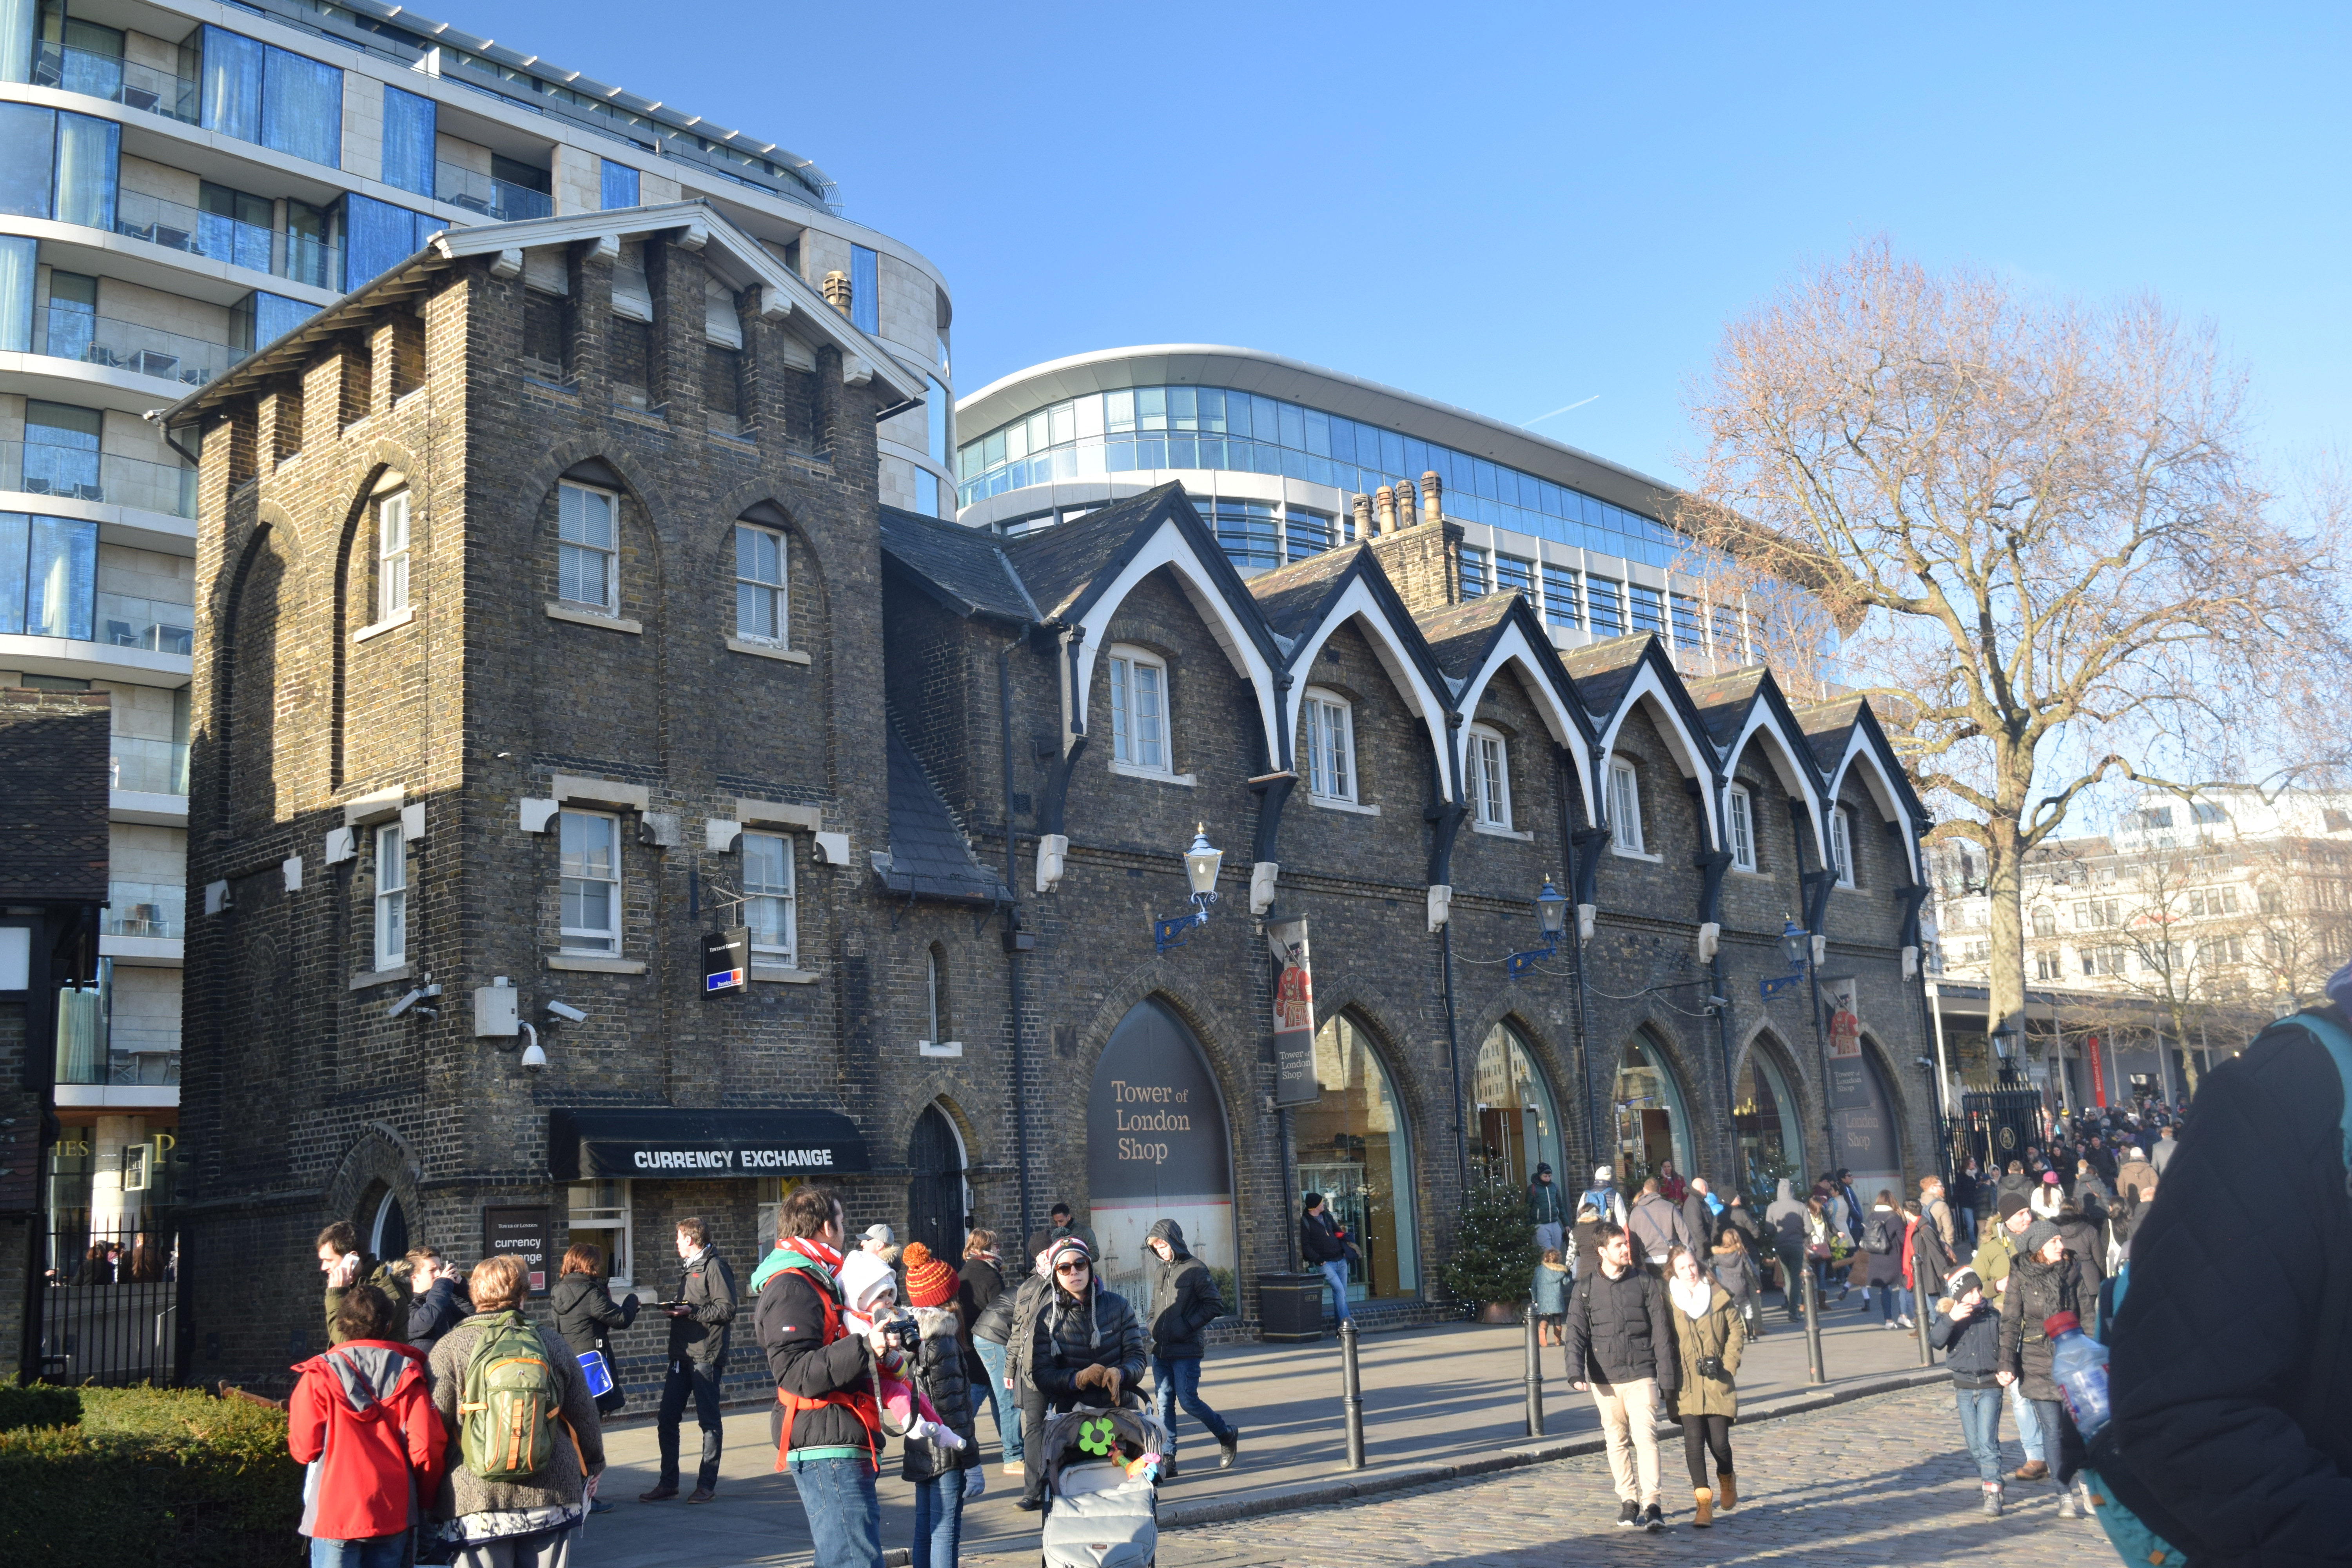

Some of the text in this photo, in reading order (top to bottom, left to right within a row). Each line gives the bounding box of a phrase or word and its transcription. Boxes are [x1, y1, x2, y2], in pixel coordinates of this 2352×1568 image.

[1279, 1051, 1303, 1059] Tower
[1281, 1060, 1311, 1069] London
[1282, 1071, 1302, 1080] Shop
[1111, 1081, 1189, 1102] Tower of
[1116, 1109, 1191, 1131] London
[1845, 1114, 1878, 1128] London
[1847, 1132, 1870, 1150] Shop
[634, 1149, 833, 1168] CURRENCY EXCHANGE
[1118, 1138, 1168, 1164] Shop
[495, 1239, 541, 1249] currency
